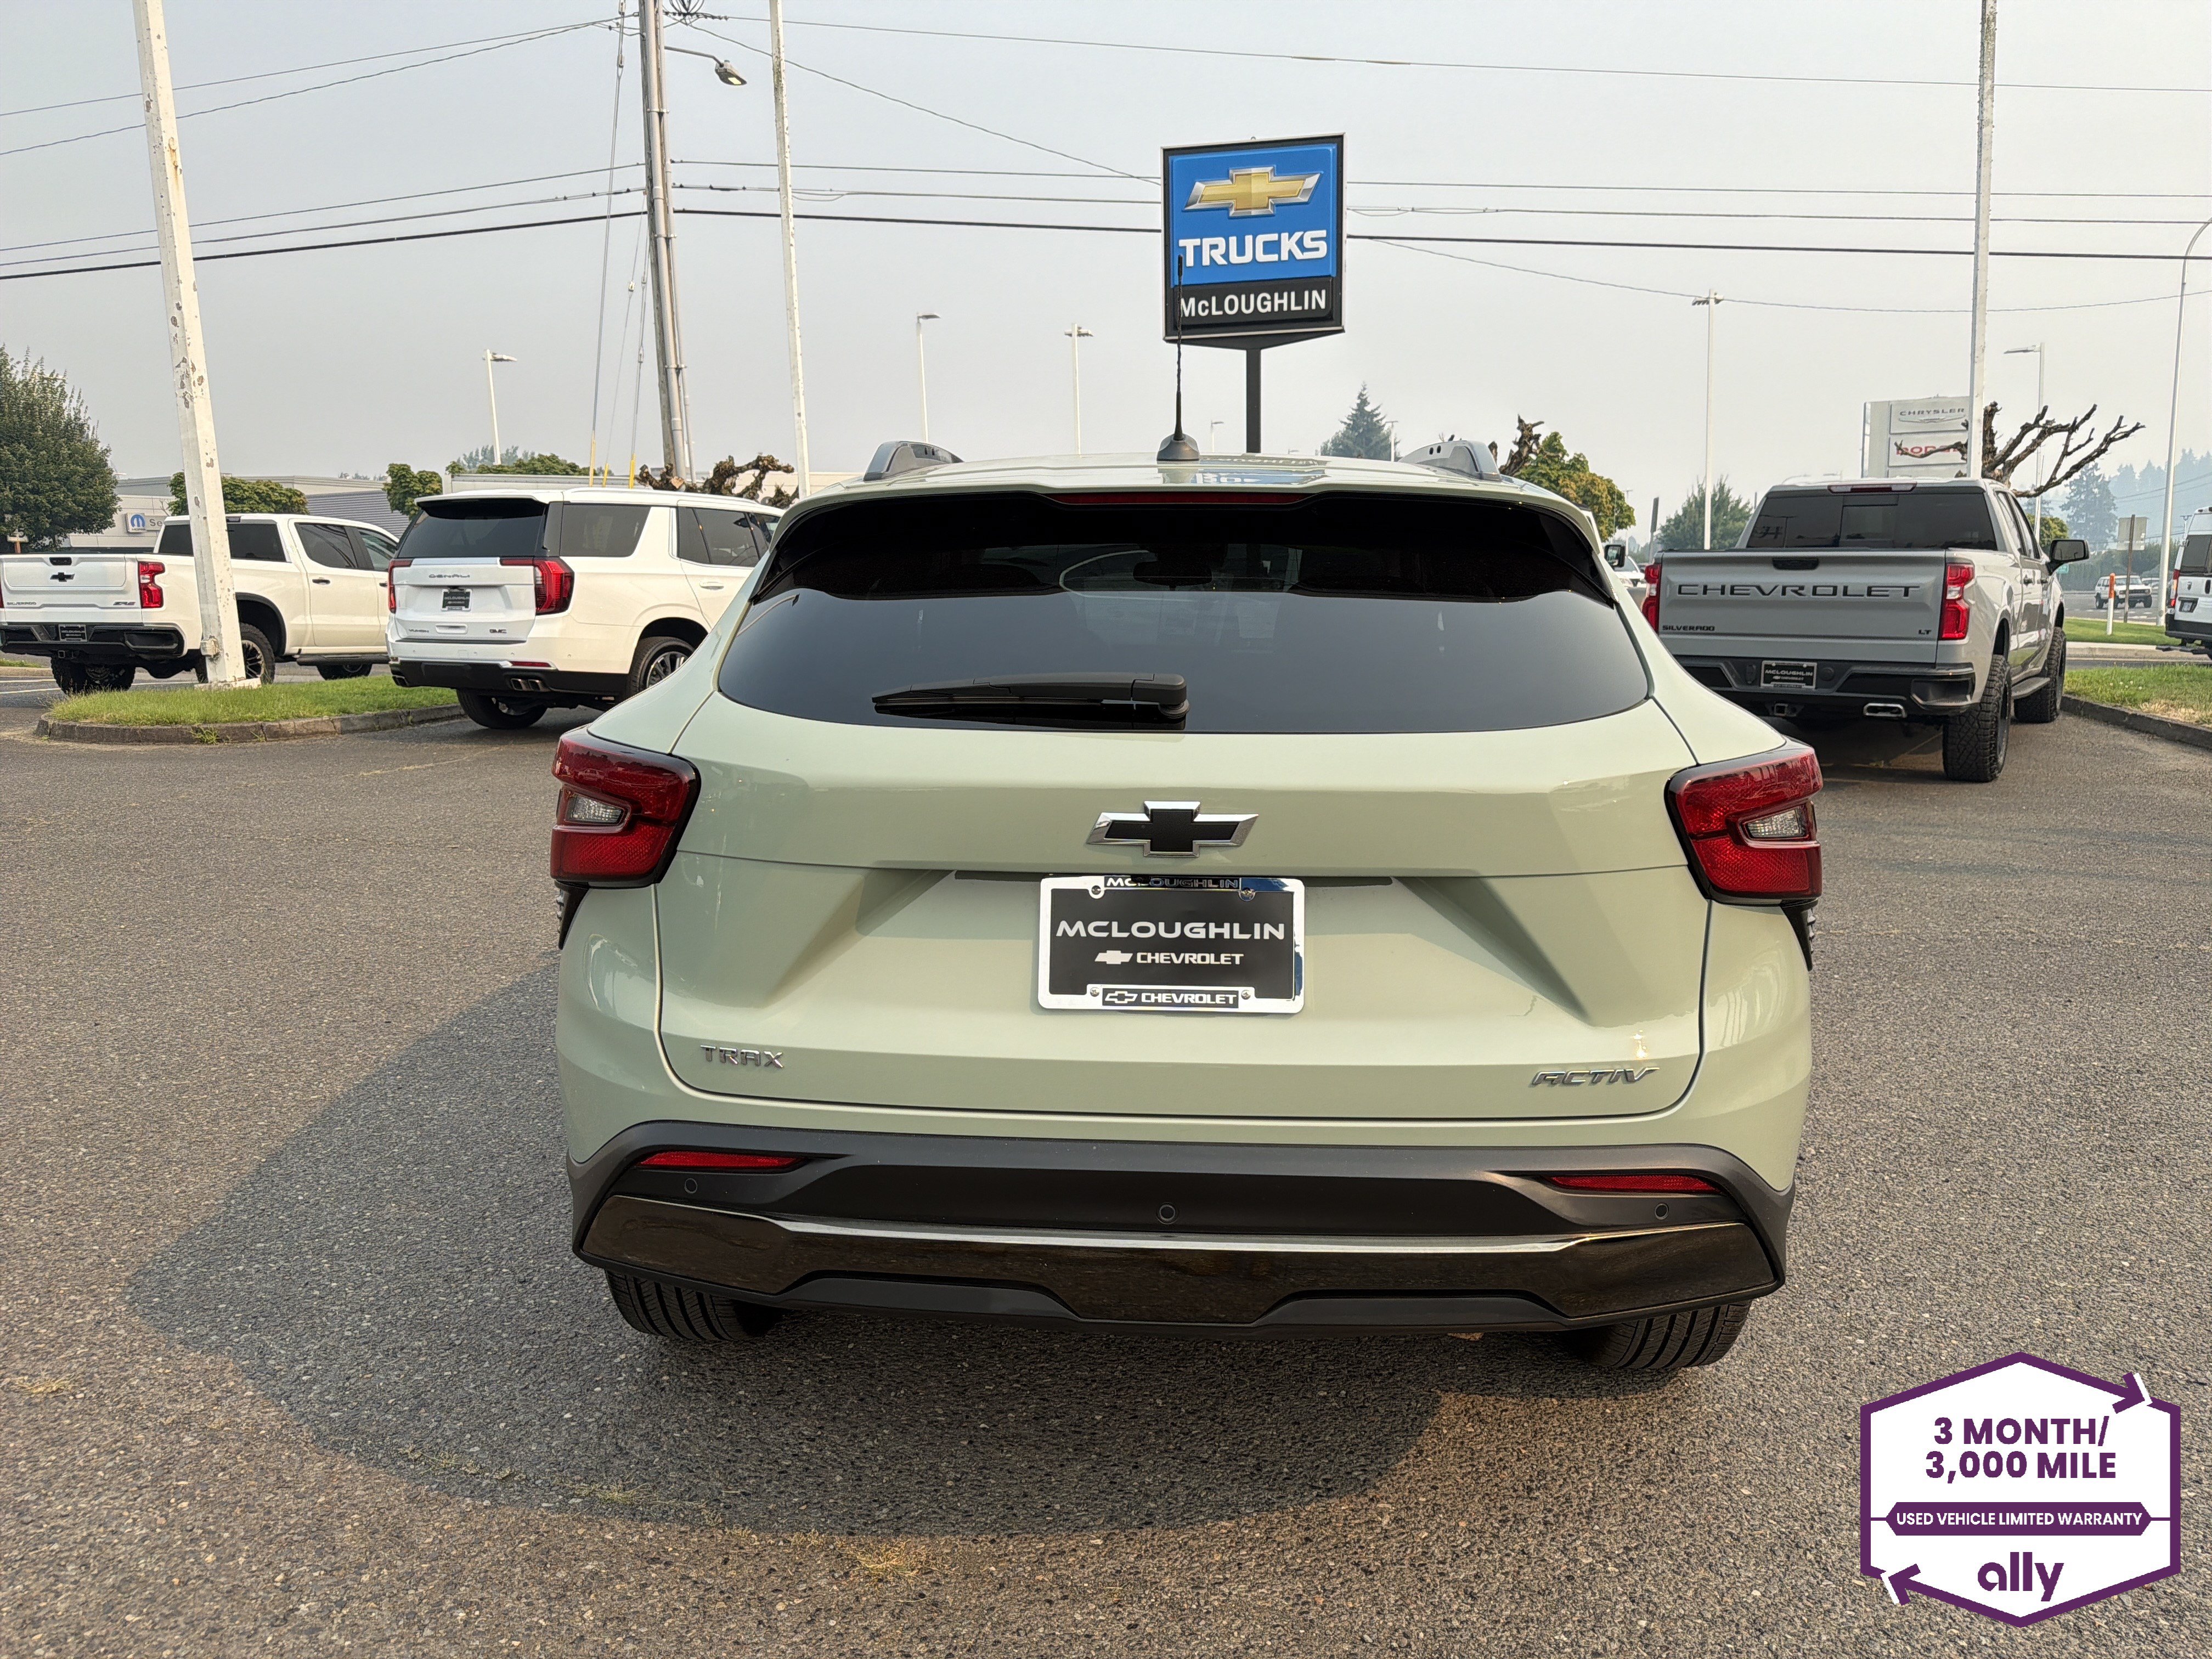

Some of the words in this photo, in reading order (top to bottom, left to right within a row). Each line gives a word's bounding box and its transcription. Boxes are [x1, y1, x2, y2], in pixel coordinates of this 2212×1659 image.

[1179, 230, 1327, 267] TRUCKS
[1181, 289, 1327, 317] McLOUGHLIN
[1897, 445, 1959, 455] DOD
[1678, 584, 1920, 598] CHEVROLET
[1056, 920, 1284, 940] MCLOUGHLIN
[1136, 952, 1244, 965] CHEVROLET
[1141, 992, 1237, 1004] CHEVROLET
[700, 1045, 783, 1068] TRAX
[1532, 1067, 1660, 1085] ACTIV
